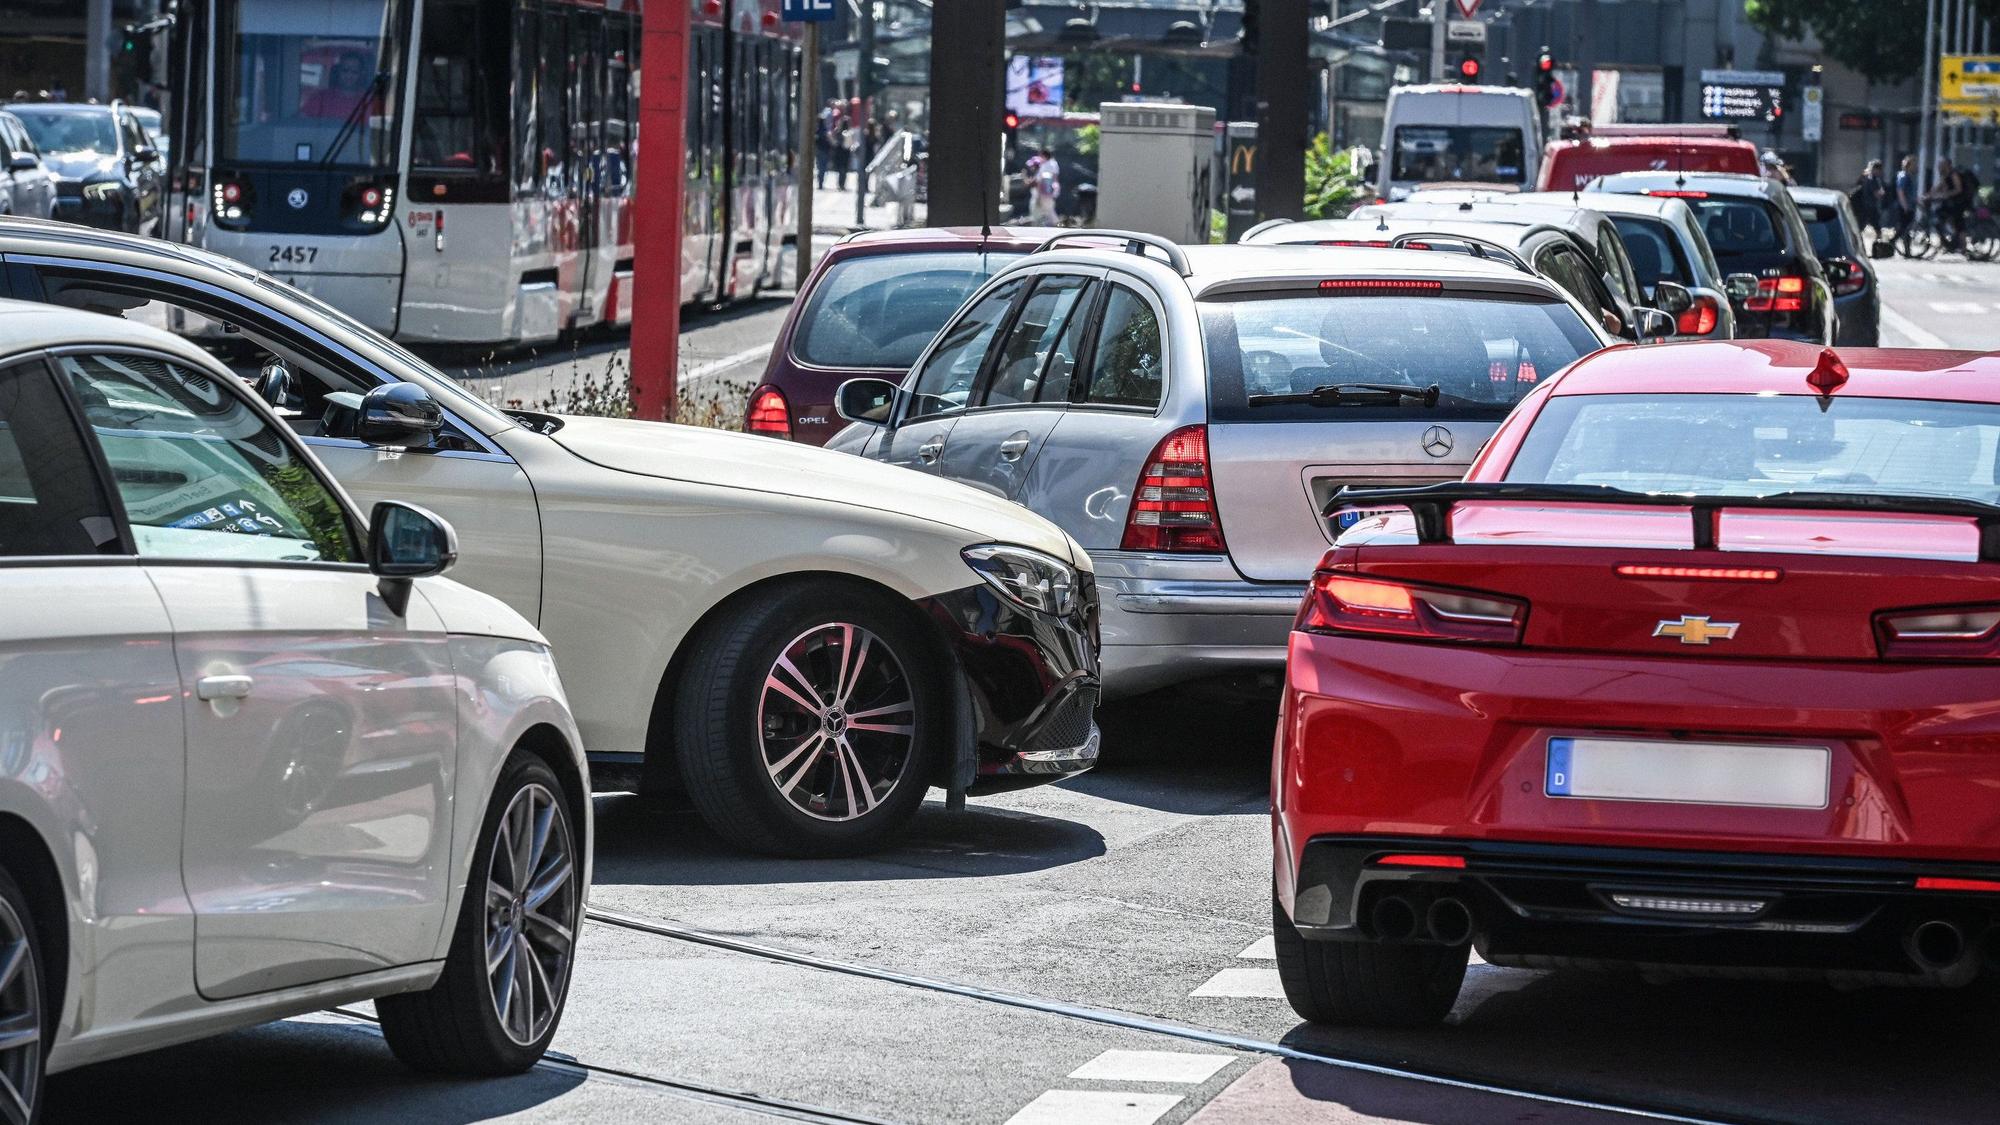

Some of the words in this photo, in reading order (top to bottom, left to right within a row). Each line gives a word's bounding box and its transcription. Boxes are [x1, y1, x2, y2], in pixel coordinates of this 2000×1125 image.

[269, 245, 318, 264] 2457
[798, 416, 829, 425] OPEL
[1554, 772, 1565, 786] D
